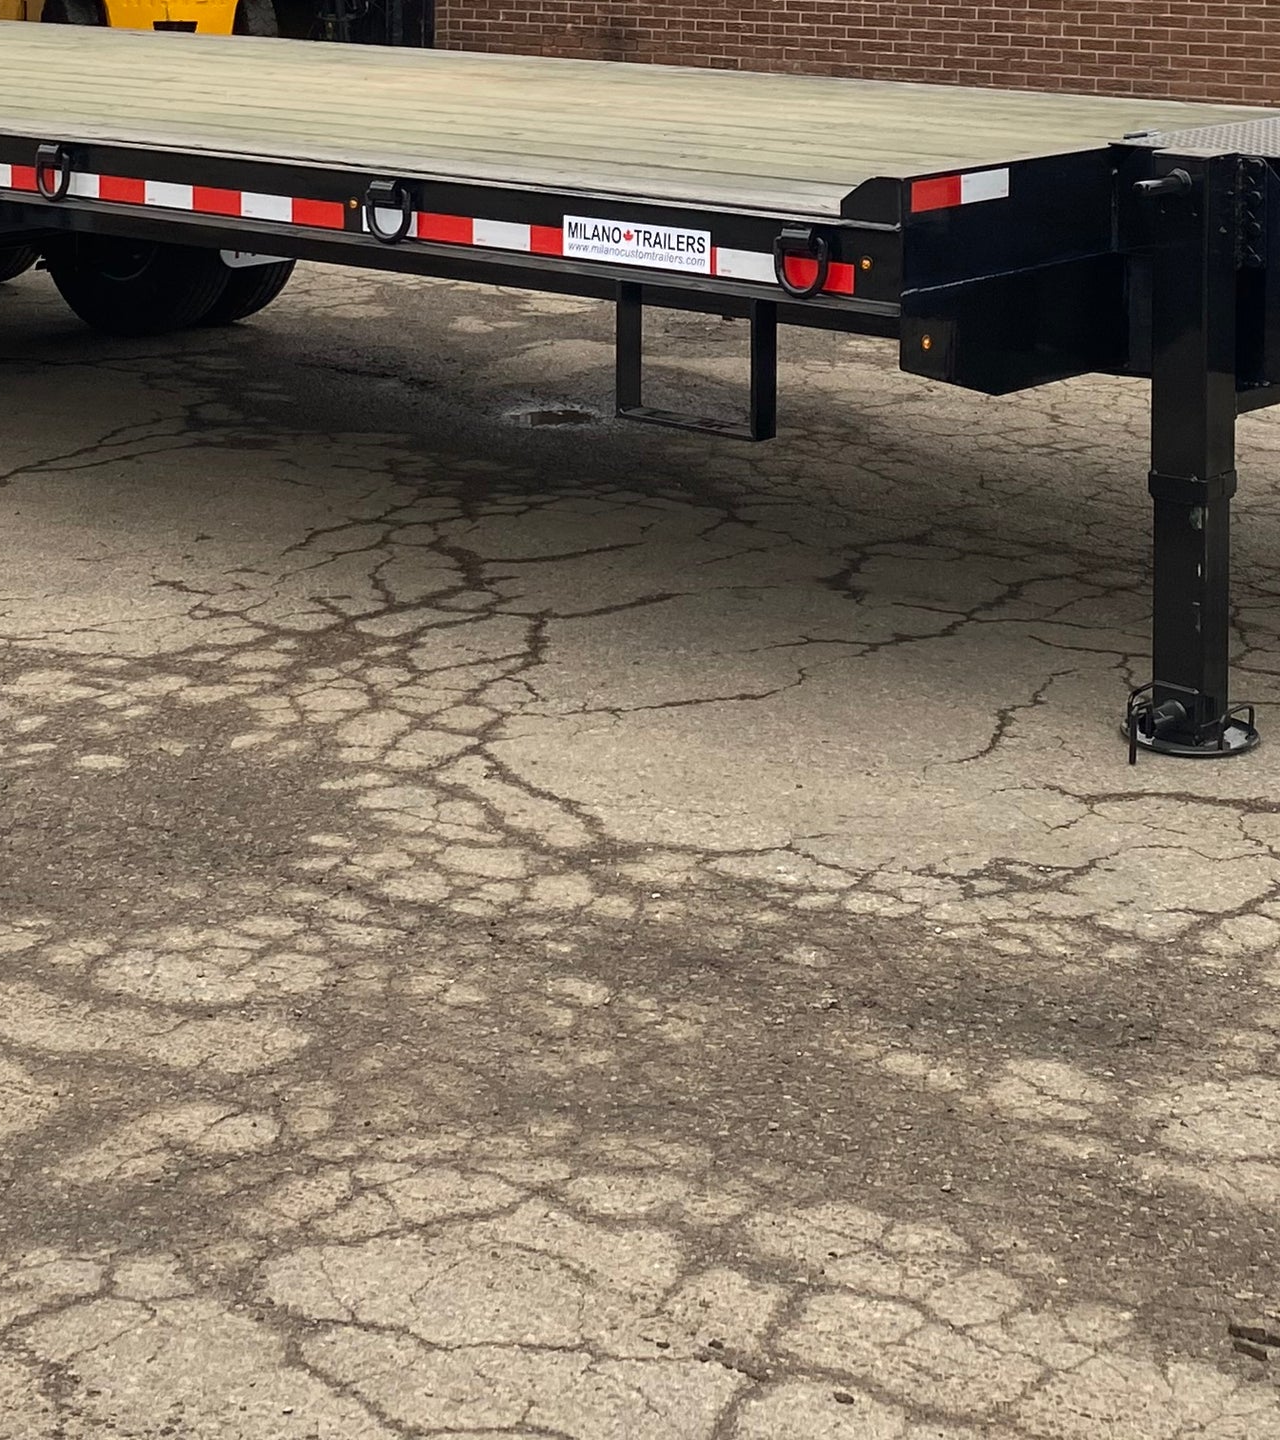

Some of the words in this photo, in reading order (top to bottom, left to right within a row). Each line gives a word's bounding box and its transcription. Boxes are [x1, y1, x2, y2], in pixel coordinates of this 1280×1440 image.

[568, 221, 621, 244] MILANO
[634, 229, 706, 254] TRAILERS
[568, 241, 706, 267] www.milanocustomtrailers.com
